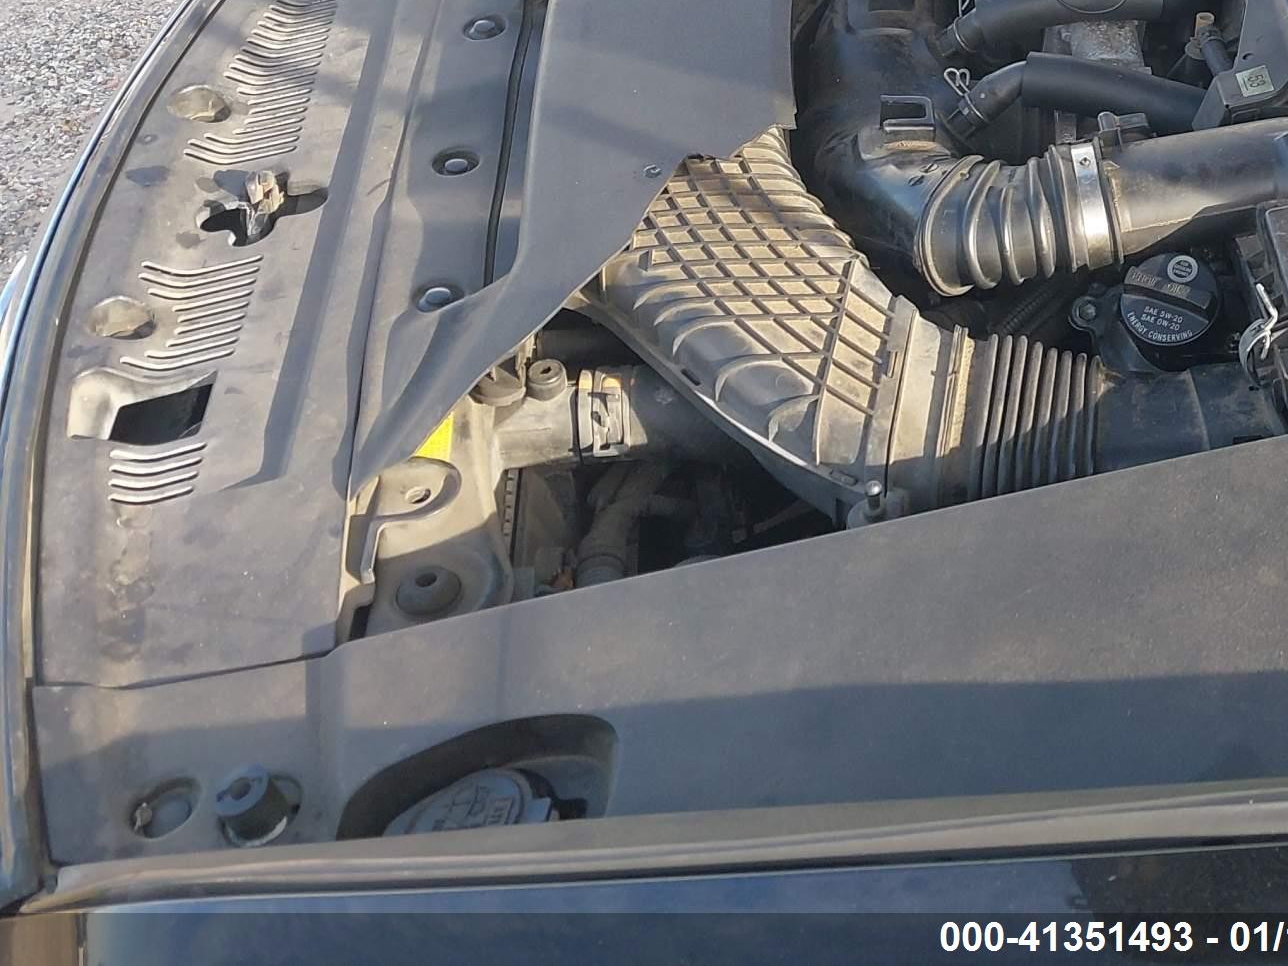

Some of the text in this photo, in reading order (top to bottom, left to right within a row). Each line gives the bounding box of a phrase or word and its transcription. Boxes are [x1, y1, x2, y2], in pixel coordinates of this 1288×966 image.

[1140, 314, 1180, 331] SAE 0W-20
[1144, 306, 1183, 323] SAE 5W-20
[1127, 311, 1193, 342] ENERGY CONSERVING
